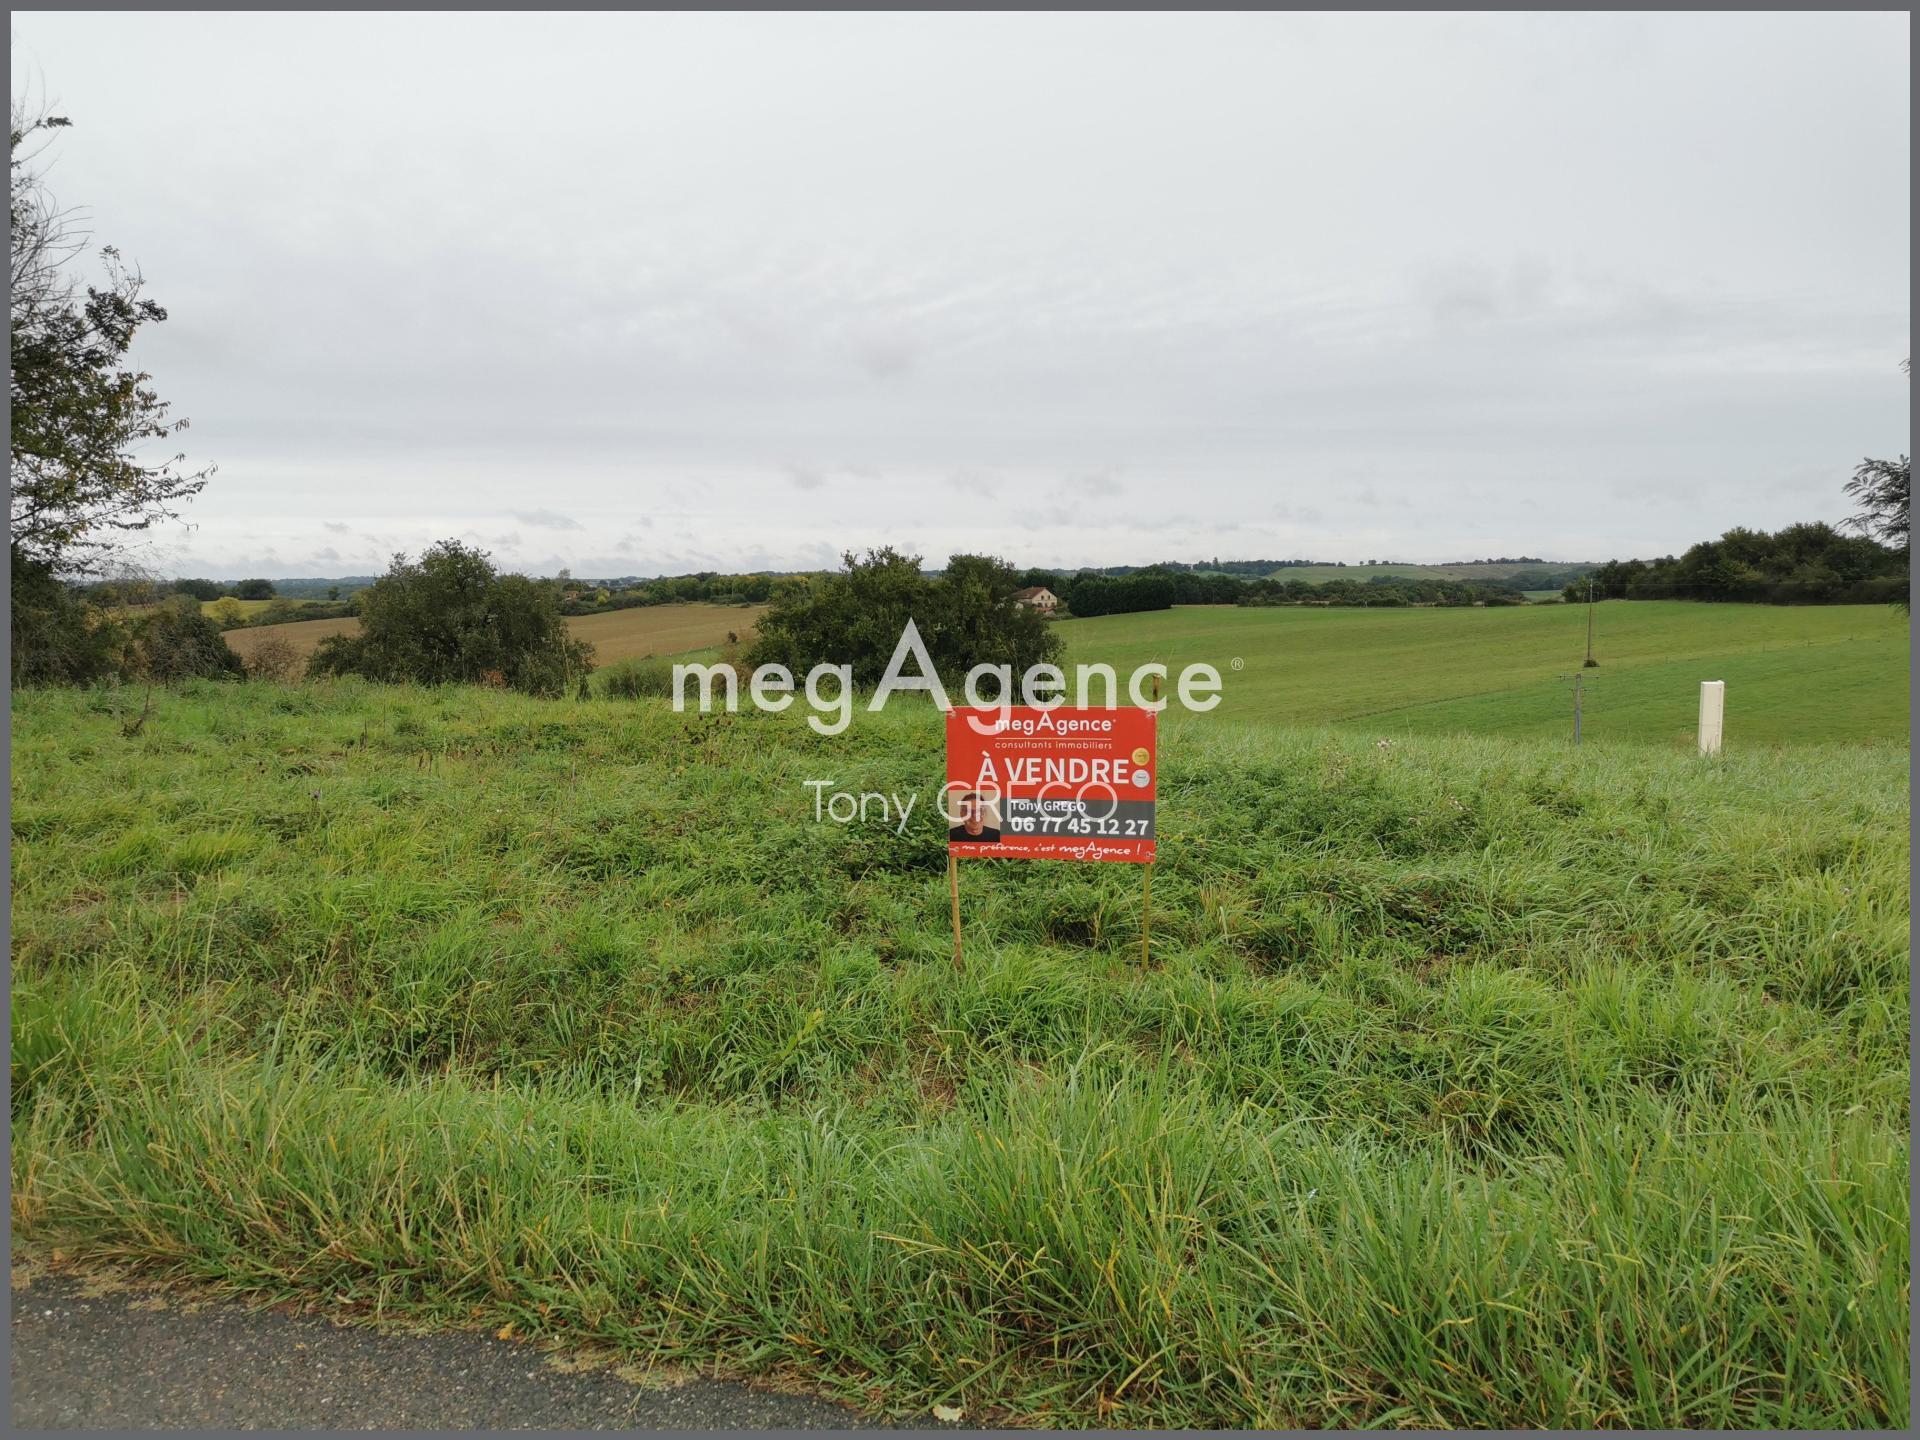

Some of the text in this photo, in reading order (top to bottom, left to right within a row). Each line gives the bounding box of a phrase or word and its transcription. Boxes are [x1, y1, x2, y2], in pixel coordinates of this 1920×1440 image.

[995, 740, 1112, 750] consultants immobiliers
[978, 750, 1130, 784] À VENDRE
[1011, 800, 1087, 813] Tony GREGO
[1011, 817, 1149, 835] 06 77 45 12 27
[1059, 841, 1131, 859] megAgence
[1136, 843, 1141, 856] !
